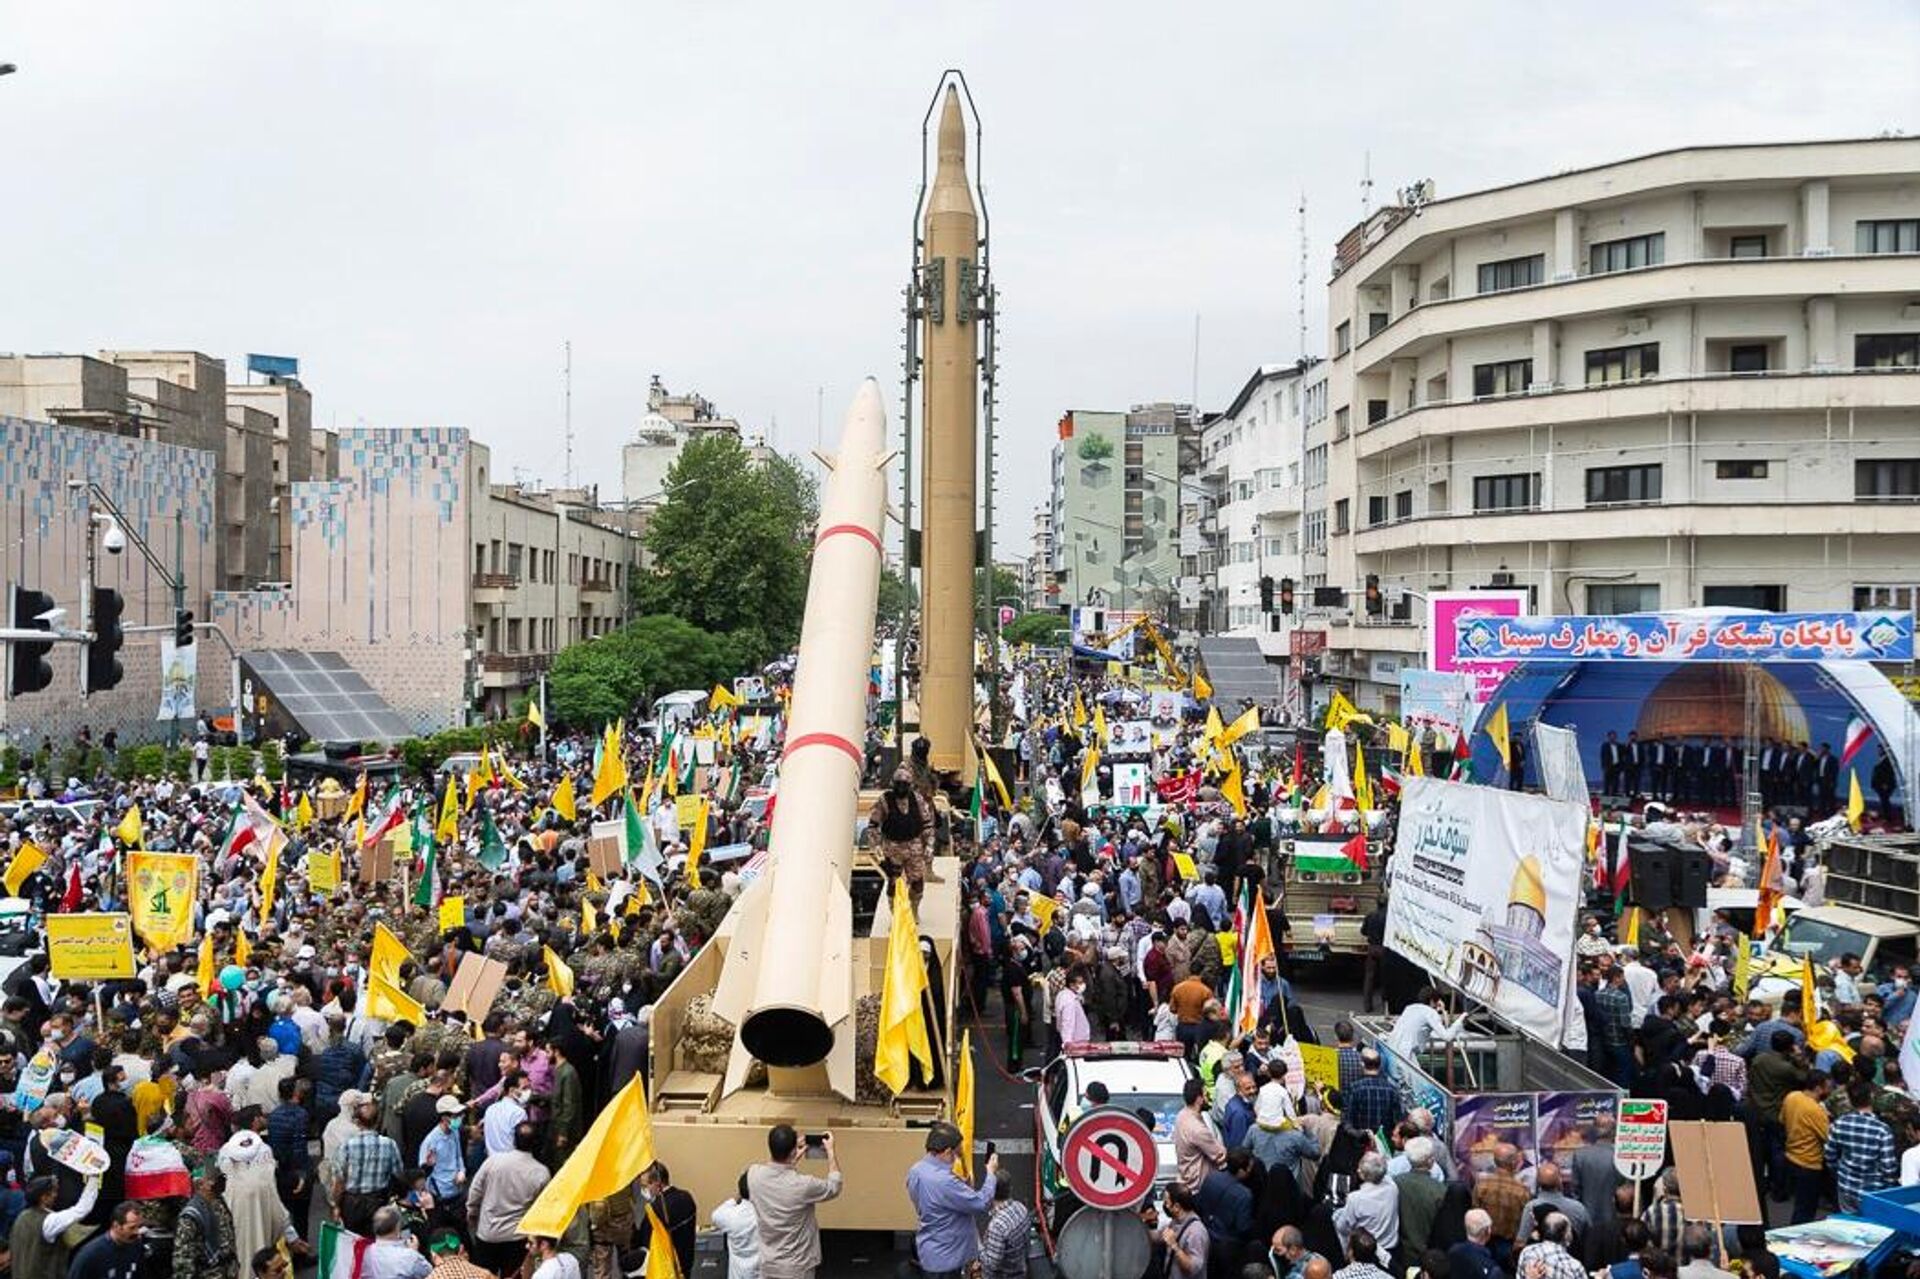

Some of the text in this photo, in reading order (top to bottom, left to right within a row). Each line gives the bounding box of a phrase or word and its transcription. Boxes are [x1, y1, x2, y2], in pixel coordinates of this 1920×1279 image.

[1500, 624, 1546, 651] سیما
[1551, 623, 1620, 654] معارف
[1626, 632, 1640, 655] و
[1717, 622, 1775, 652] شبکه
[1782, 623, 1854, 655] پایگاه
